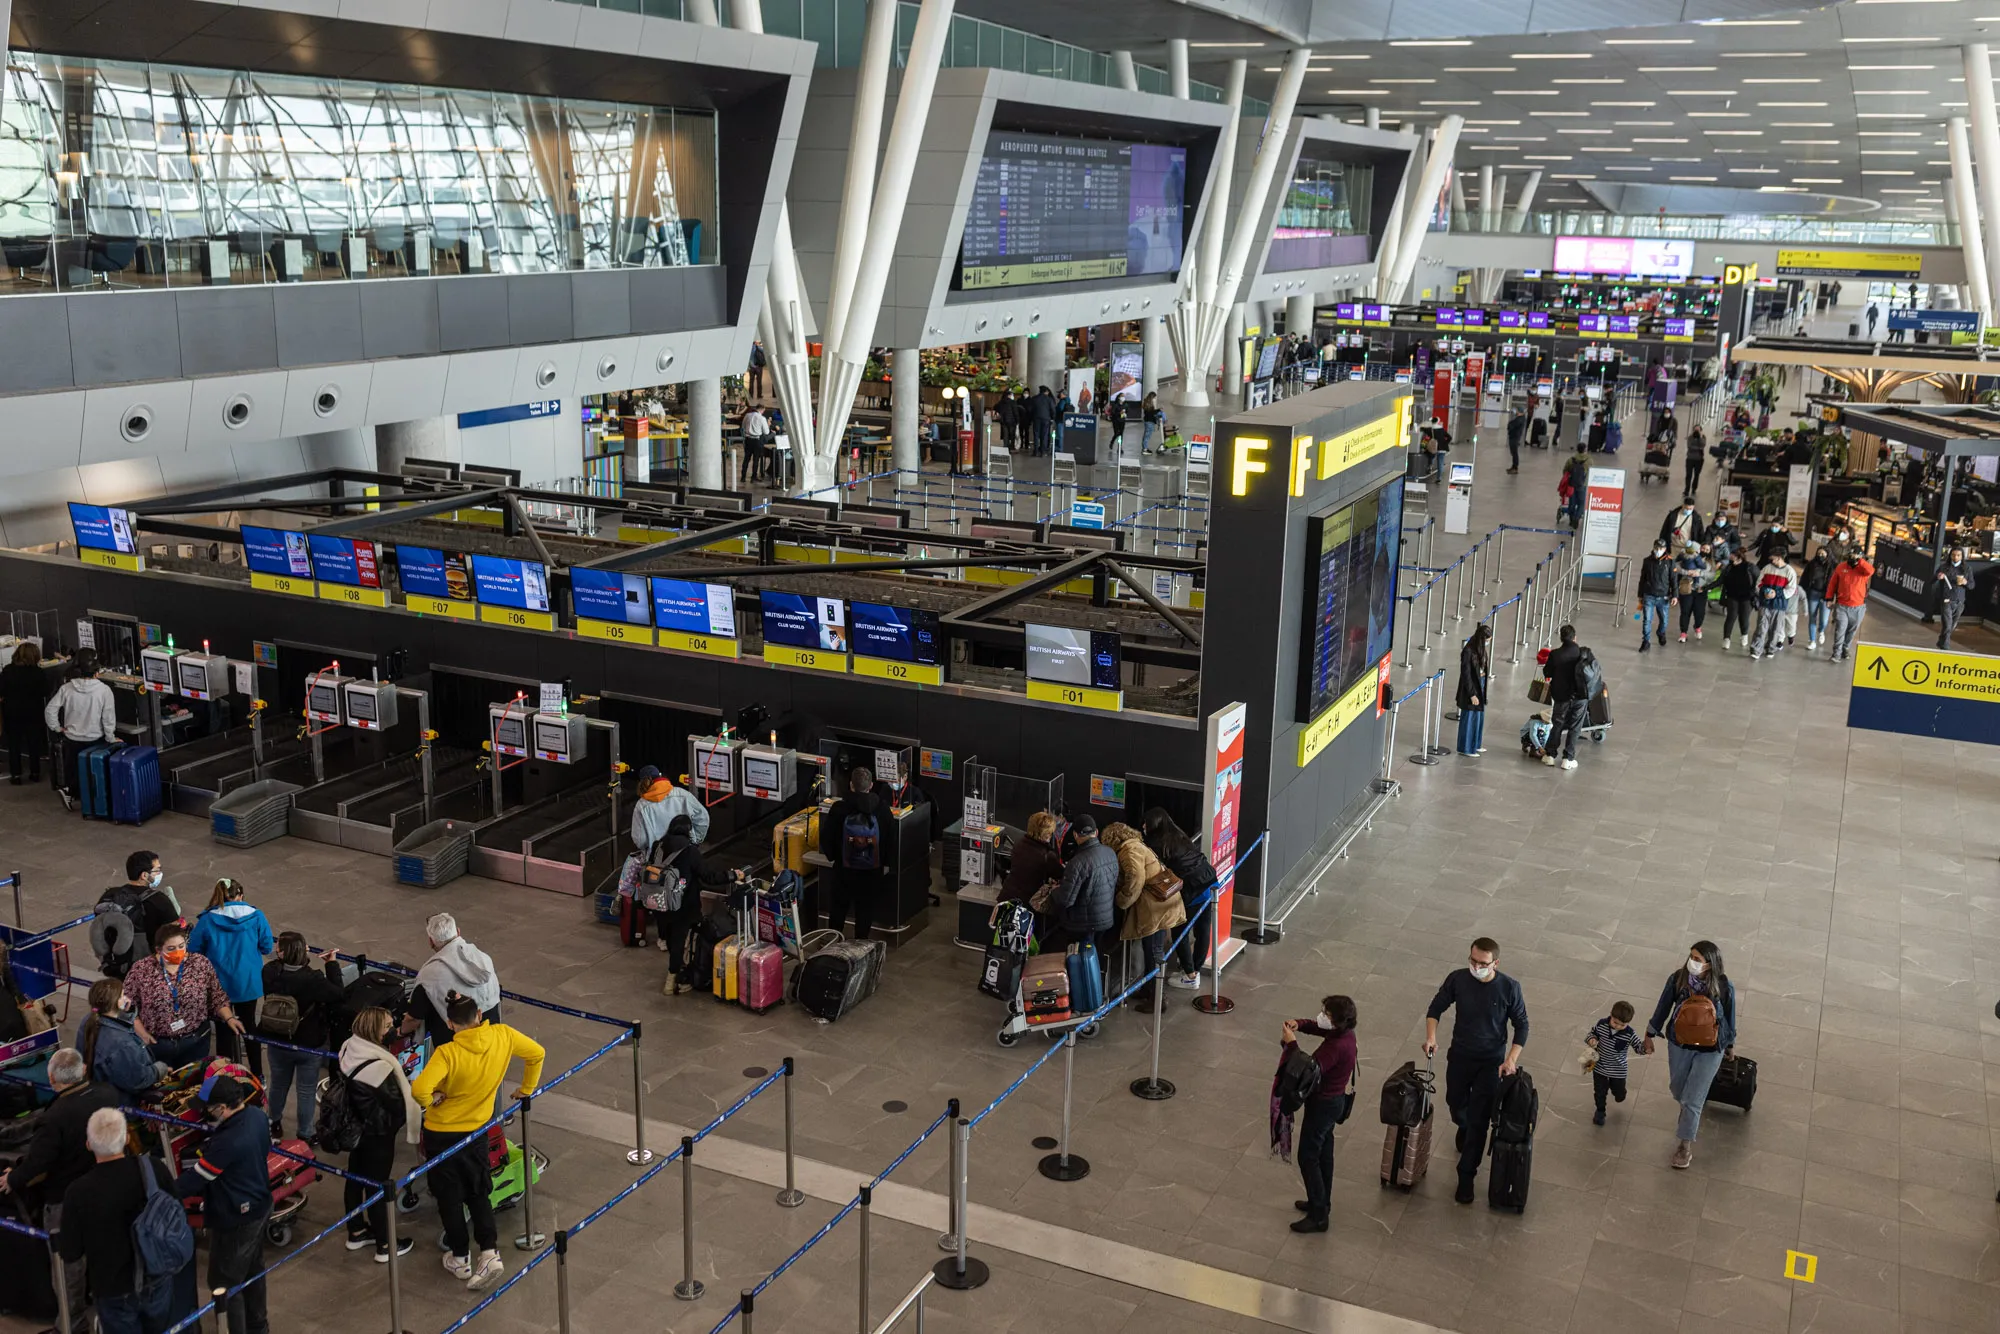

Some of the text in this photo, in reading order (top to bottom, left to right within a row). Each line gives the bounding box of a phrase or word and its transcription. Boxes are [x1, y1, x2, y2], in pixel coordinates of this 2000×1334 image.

[1001, 142, 1038, 153] AEROPUERTO
[1041, 145, 1062, 154] ARTURO
[1065, 147, 1084, 156] MERINO
[1725, 266, 1742, 284] D
[1400, 396, 1414, 446] E
[1232, 437, 1269, 496] F
[1292, 436, 1313, 497] F
[102, 555, 116, 565] F10
[275, 579, 290, 590] F09
[1886, 566, 1925, 595] CAFÉ BAKERY
[344, 589, 360, 600] F08
[432, 604, 448, 613] F07
[508, 612, 525, 624] F06
[606, 626, 624, 638] F05
[689, 638, 707, 650] F04
[795, 652, 815, 665] F03
[887, 665, 907, 678] F02
[1062, 690, 1083, 703] F01
[1356, 693, 1360, 710] A
[1327, 718, 1331, 736] F
[1335, 712, 1339, 730] H
